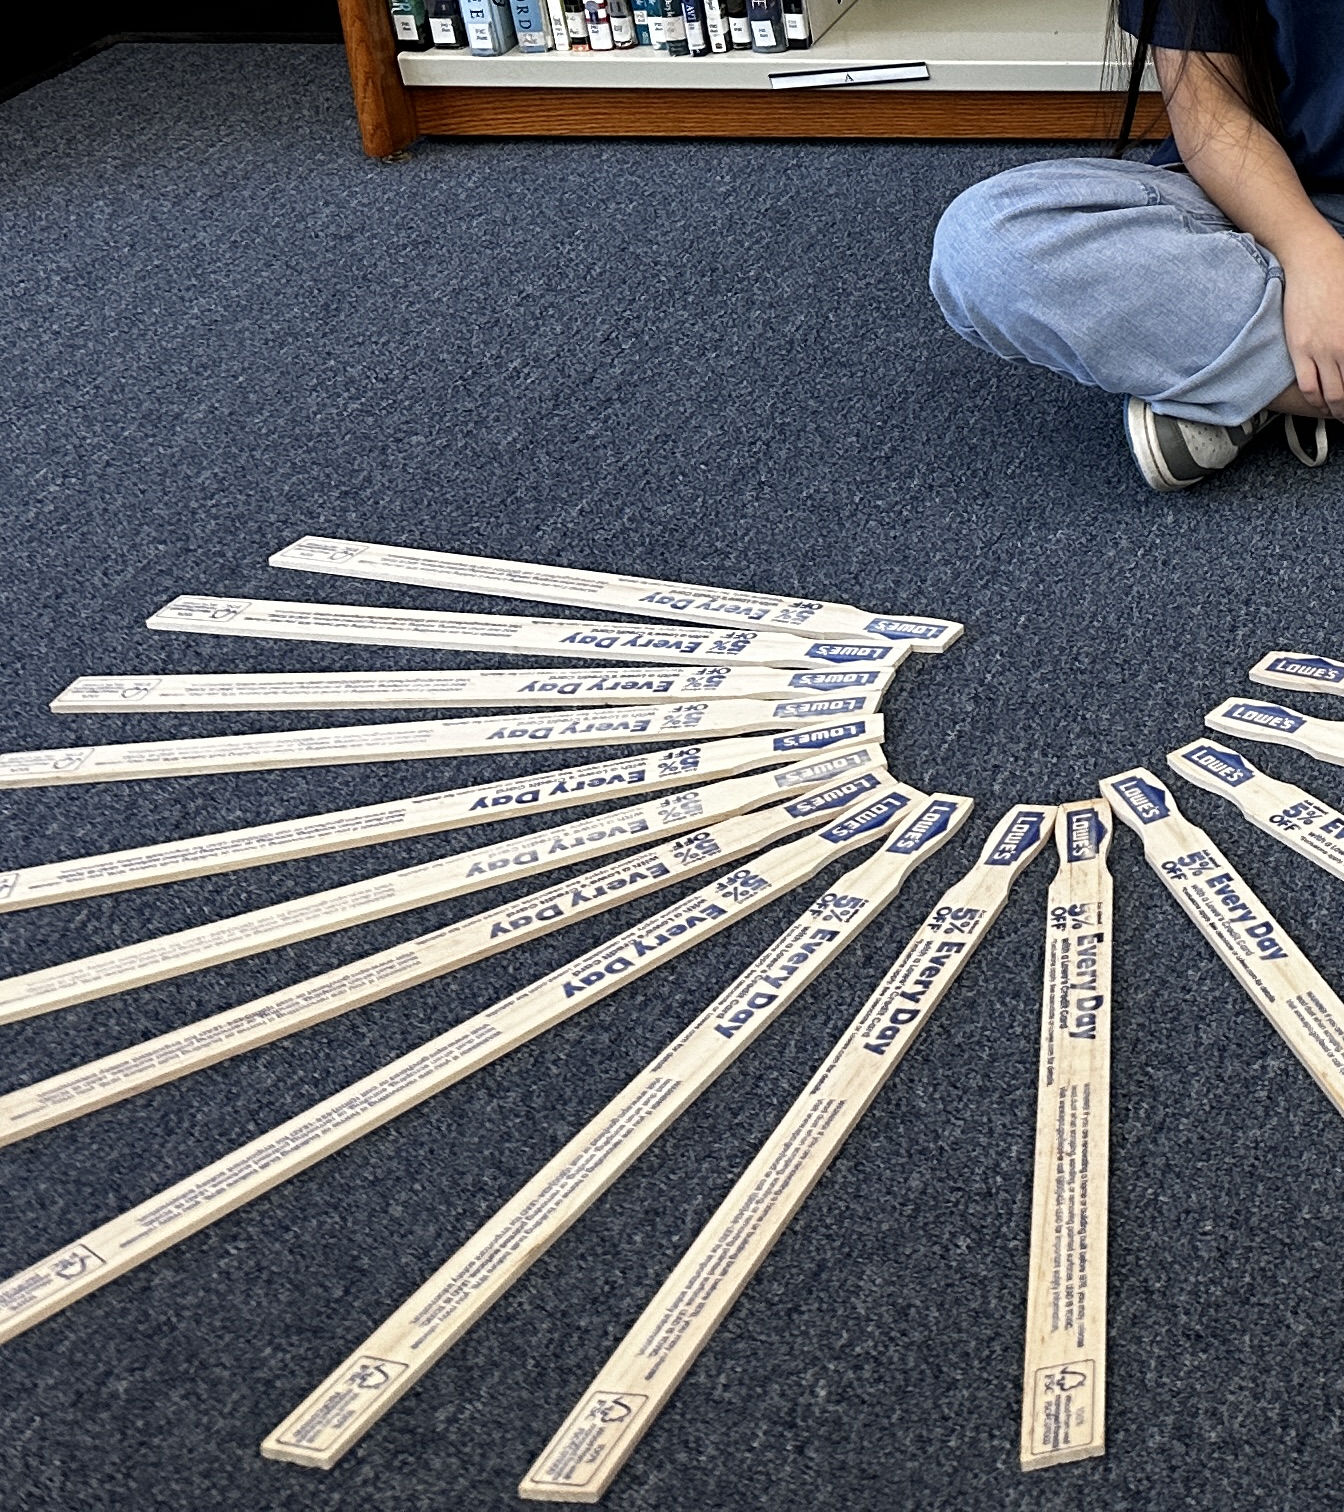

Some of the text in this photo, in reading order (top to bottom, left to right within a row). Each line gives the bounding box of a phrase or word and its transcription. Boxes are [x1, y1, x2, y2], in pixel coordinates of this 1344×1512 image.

[844, 73, 855, 83] A
[873, 617, 942, 640] LOWE'S
[815, 644, 887, 659] LOWE'S
[1274, 659, 1337, 680] LOWE'S
[1230, 707, 1295, 730] LOWE'S
[783, 723, 860, 748] LOWE'S
[1198, 747, 1244, 782] LOWE'S
[1117, 779, 1160, 821] LOWE'S
[831, 792, 904, 838] LOWE'S
[1268, 815, 1296, 835] OFF
[1282, 802, 1315, 826] 5%
[898, 802, 946, 850] LOWE'S
